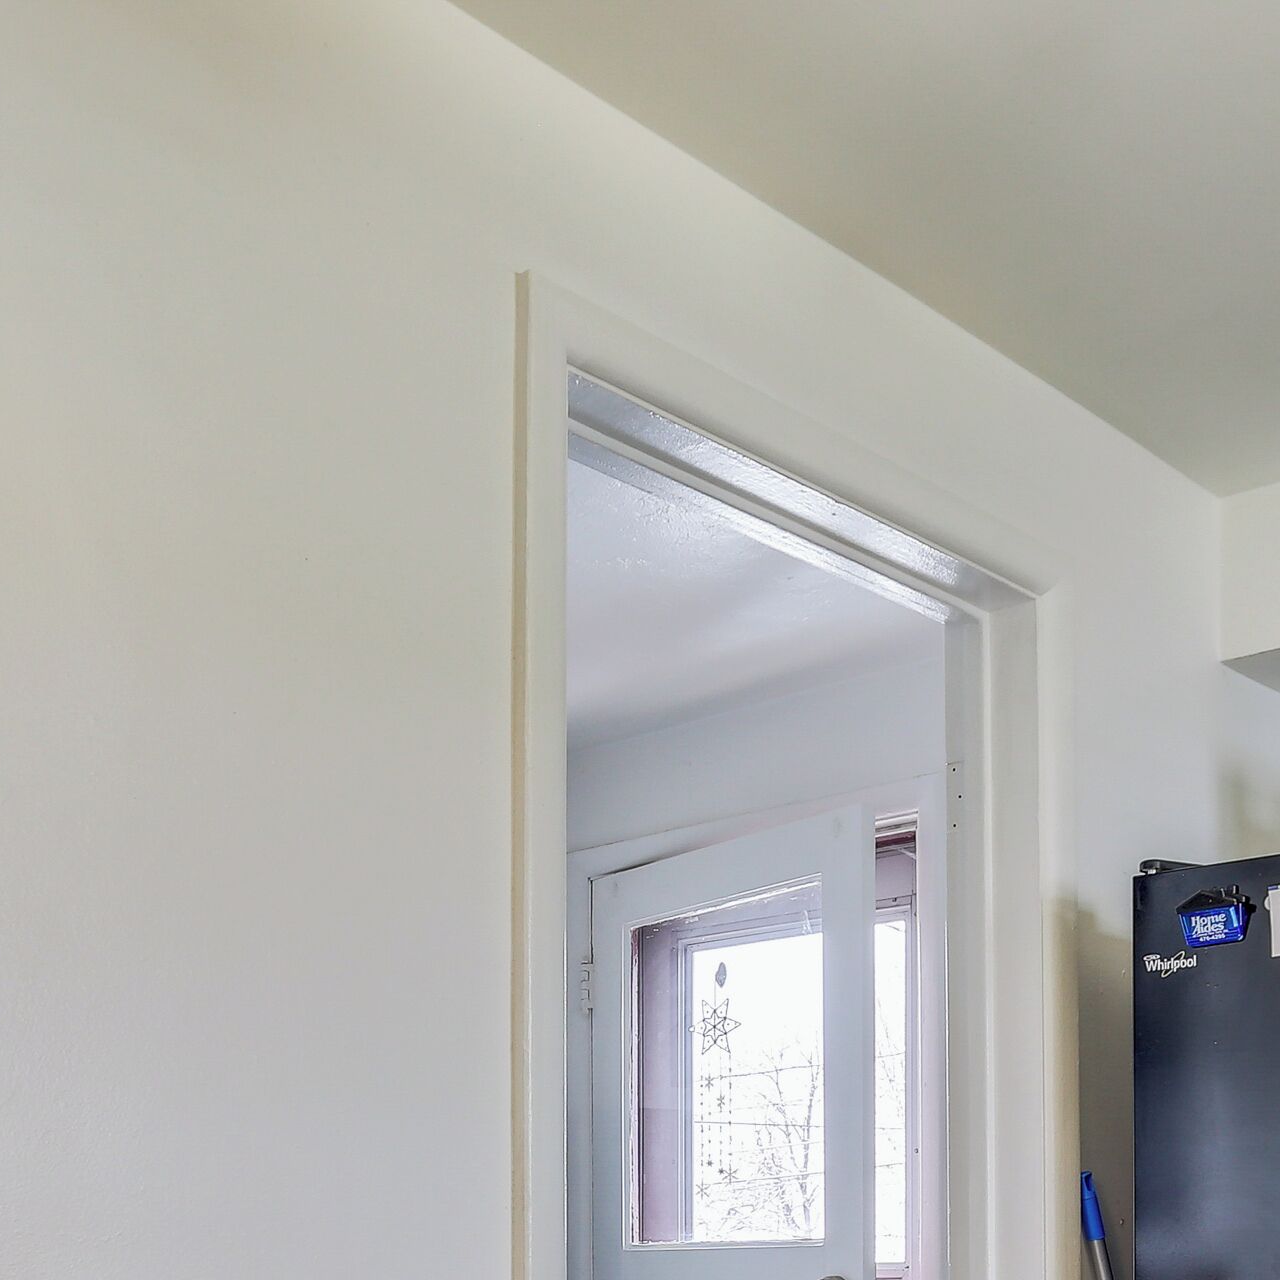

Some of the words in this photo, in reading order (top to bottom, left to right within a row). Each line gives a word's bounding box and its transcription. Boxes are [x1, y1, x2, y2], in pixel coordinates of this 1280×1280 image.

[1190, 913, 1227, 927] Home
[1192, 922, 1225, 935] Aides
[1144, 952, 1197, 974] Whirlpool
